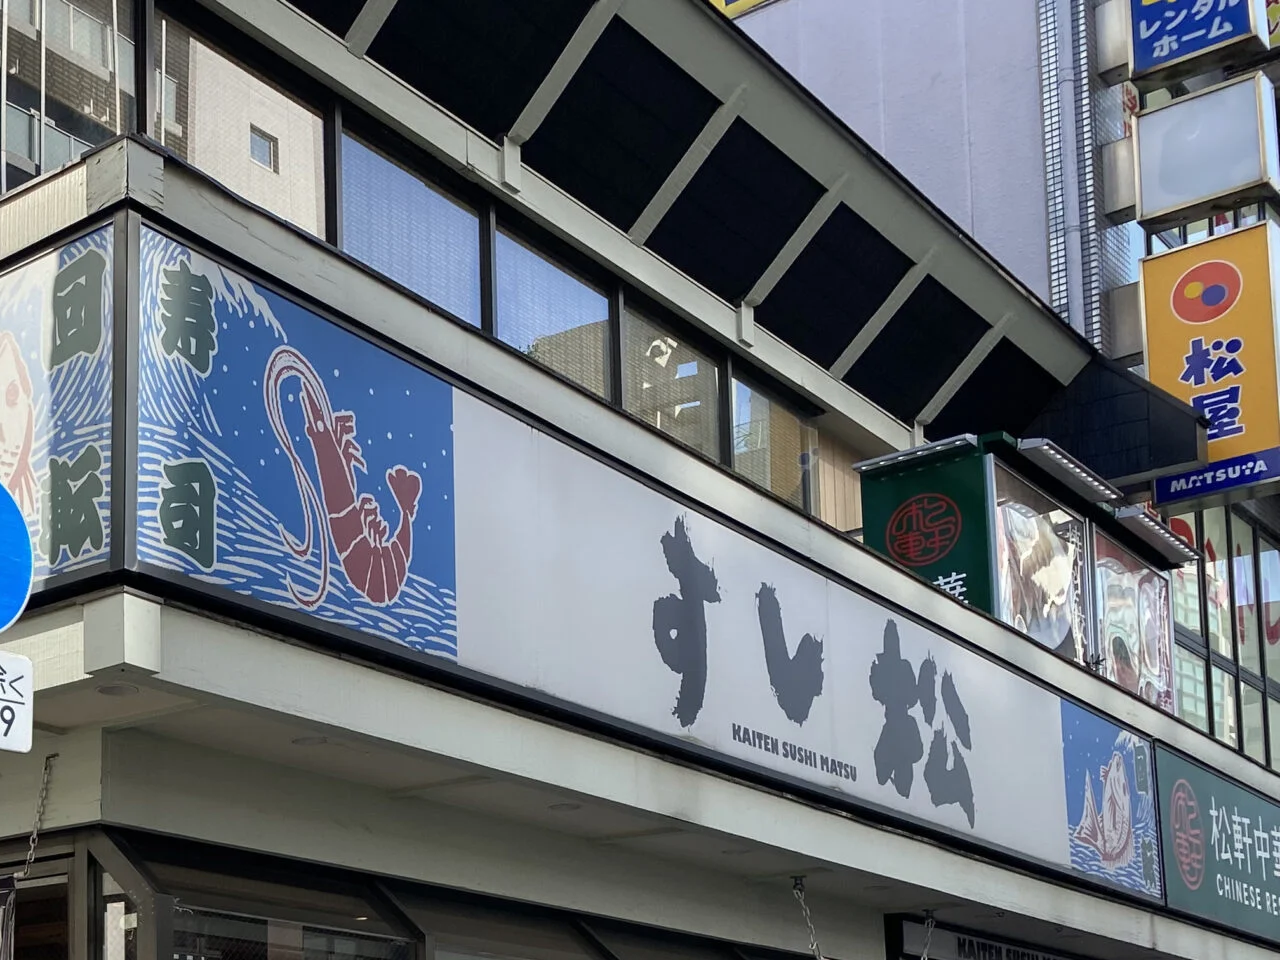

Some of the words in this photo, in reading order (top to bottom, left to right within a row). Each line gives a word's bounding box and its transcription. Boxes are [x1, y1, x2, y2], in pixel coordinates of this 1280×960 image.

[1153, 16, 1233, 58] ホーム
[161, 260, 218, 568] 寿司
[1179, 336, 1246, 443] 松屋
[1171, 460, 1268, 493] MATSUYA
[652, 512, 975, 830] すし松
[732, 721, 779, 756] KAITEN
[782, 740, 818, 770] SUSHI
[820, 752, 858, 782] MATSU
[1216, 873, 1262, 910] CHINESE
